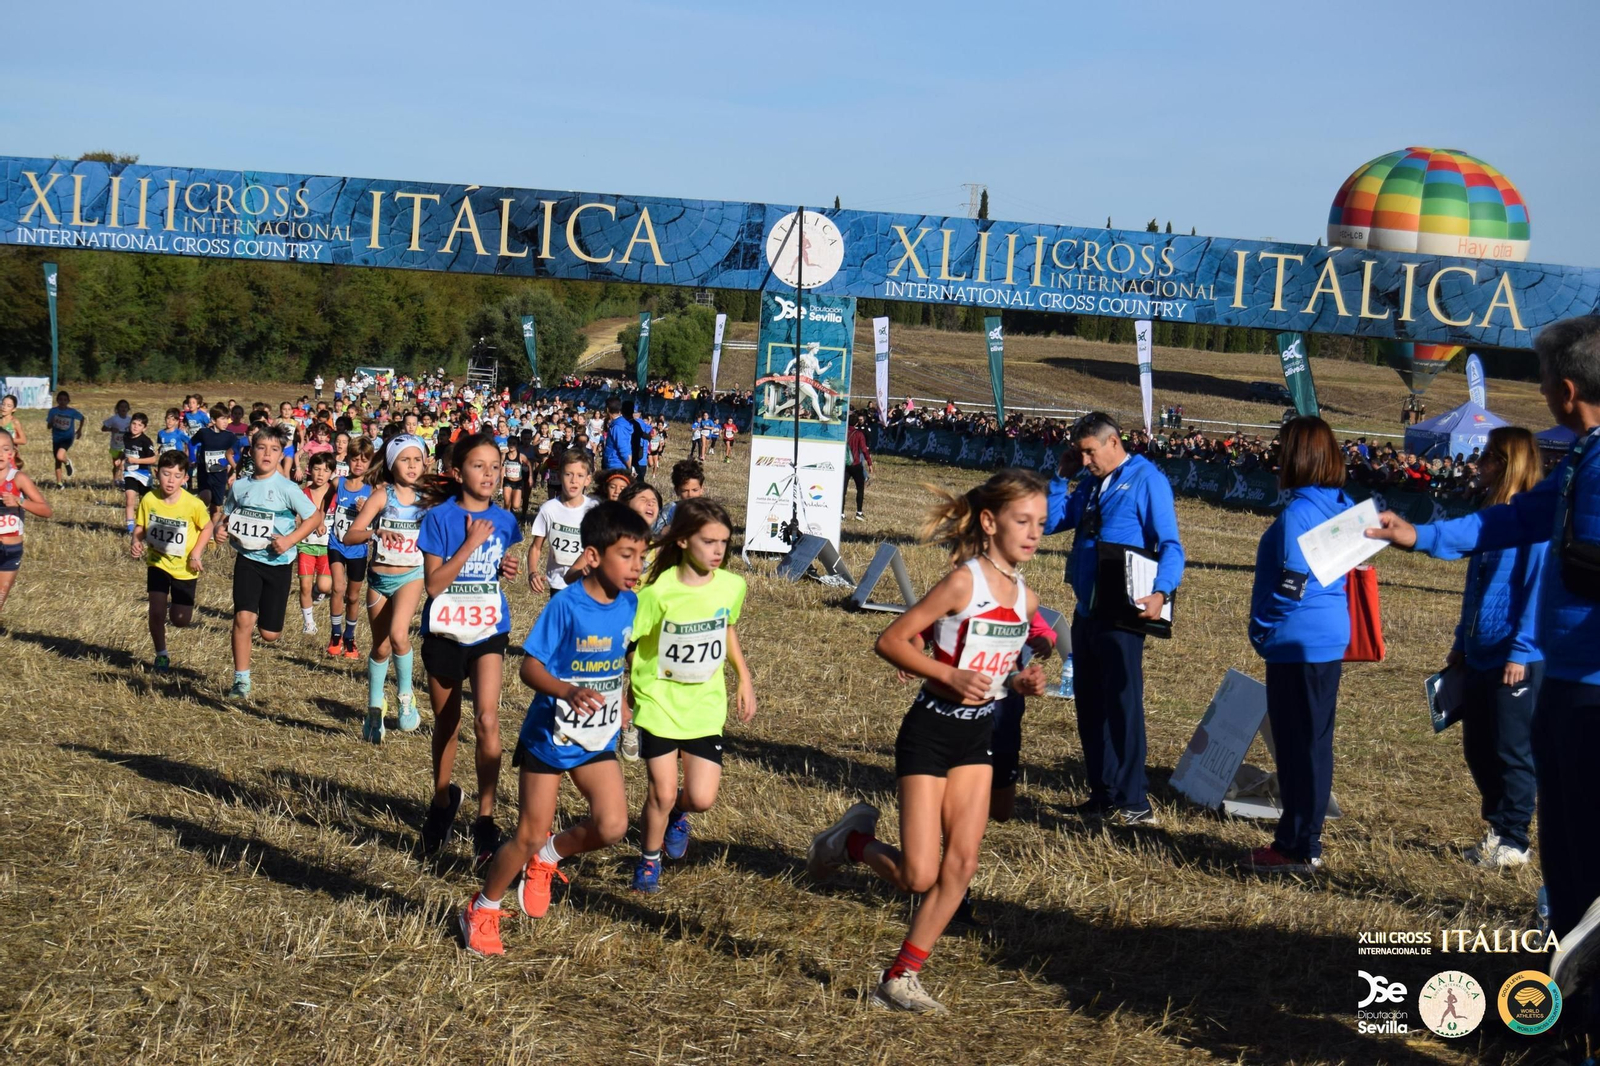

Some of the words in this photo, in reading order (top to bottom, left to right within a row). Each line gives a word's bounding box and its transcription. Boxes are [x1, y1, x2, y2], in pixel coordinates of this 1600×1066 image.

[18, 171, 180, 232] XLIII
[184, 182, 310, 218] CROSS
[184, 216, 354, 242] INTERNACIONAL
[366, 184, 670, 267] ITÁLICA
[17, 228, 168, 252] INTERNATIONAL
[173, 236, 230, 255] CROSS
[234, 239, 323, 260] COUNTRY
[886, 225, 1048, 288] XLIII
[1052, 239, 1175, 277] CROSS
[1458, 238, 1488, 258] Hay
[885, 281, 1035, 308] INTERNATIONAL
[1039, 291, 1095, 312] CROSS
[1098, 297, 1188, 318] COUNTRY
[1050, 273, 1218, 301] INTERNACIONAL
[1229, 246, 1528, 331] ITÁLICA
[809, 312, 843, 323] Sevilla
[150, 527, 184, 545] 4120
[232, 520, 270, 539] 4112
[551, 536, 583, 553] 423
[436, 605, 498, 626] 4433
[665, 639, 722, 664] 4270
[571, 659, 611, 673] OLIMPO
[563, 700, 619, 729] 4216
